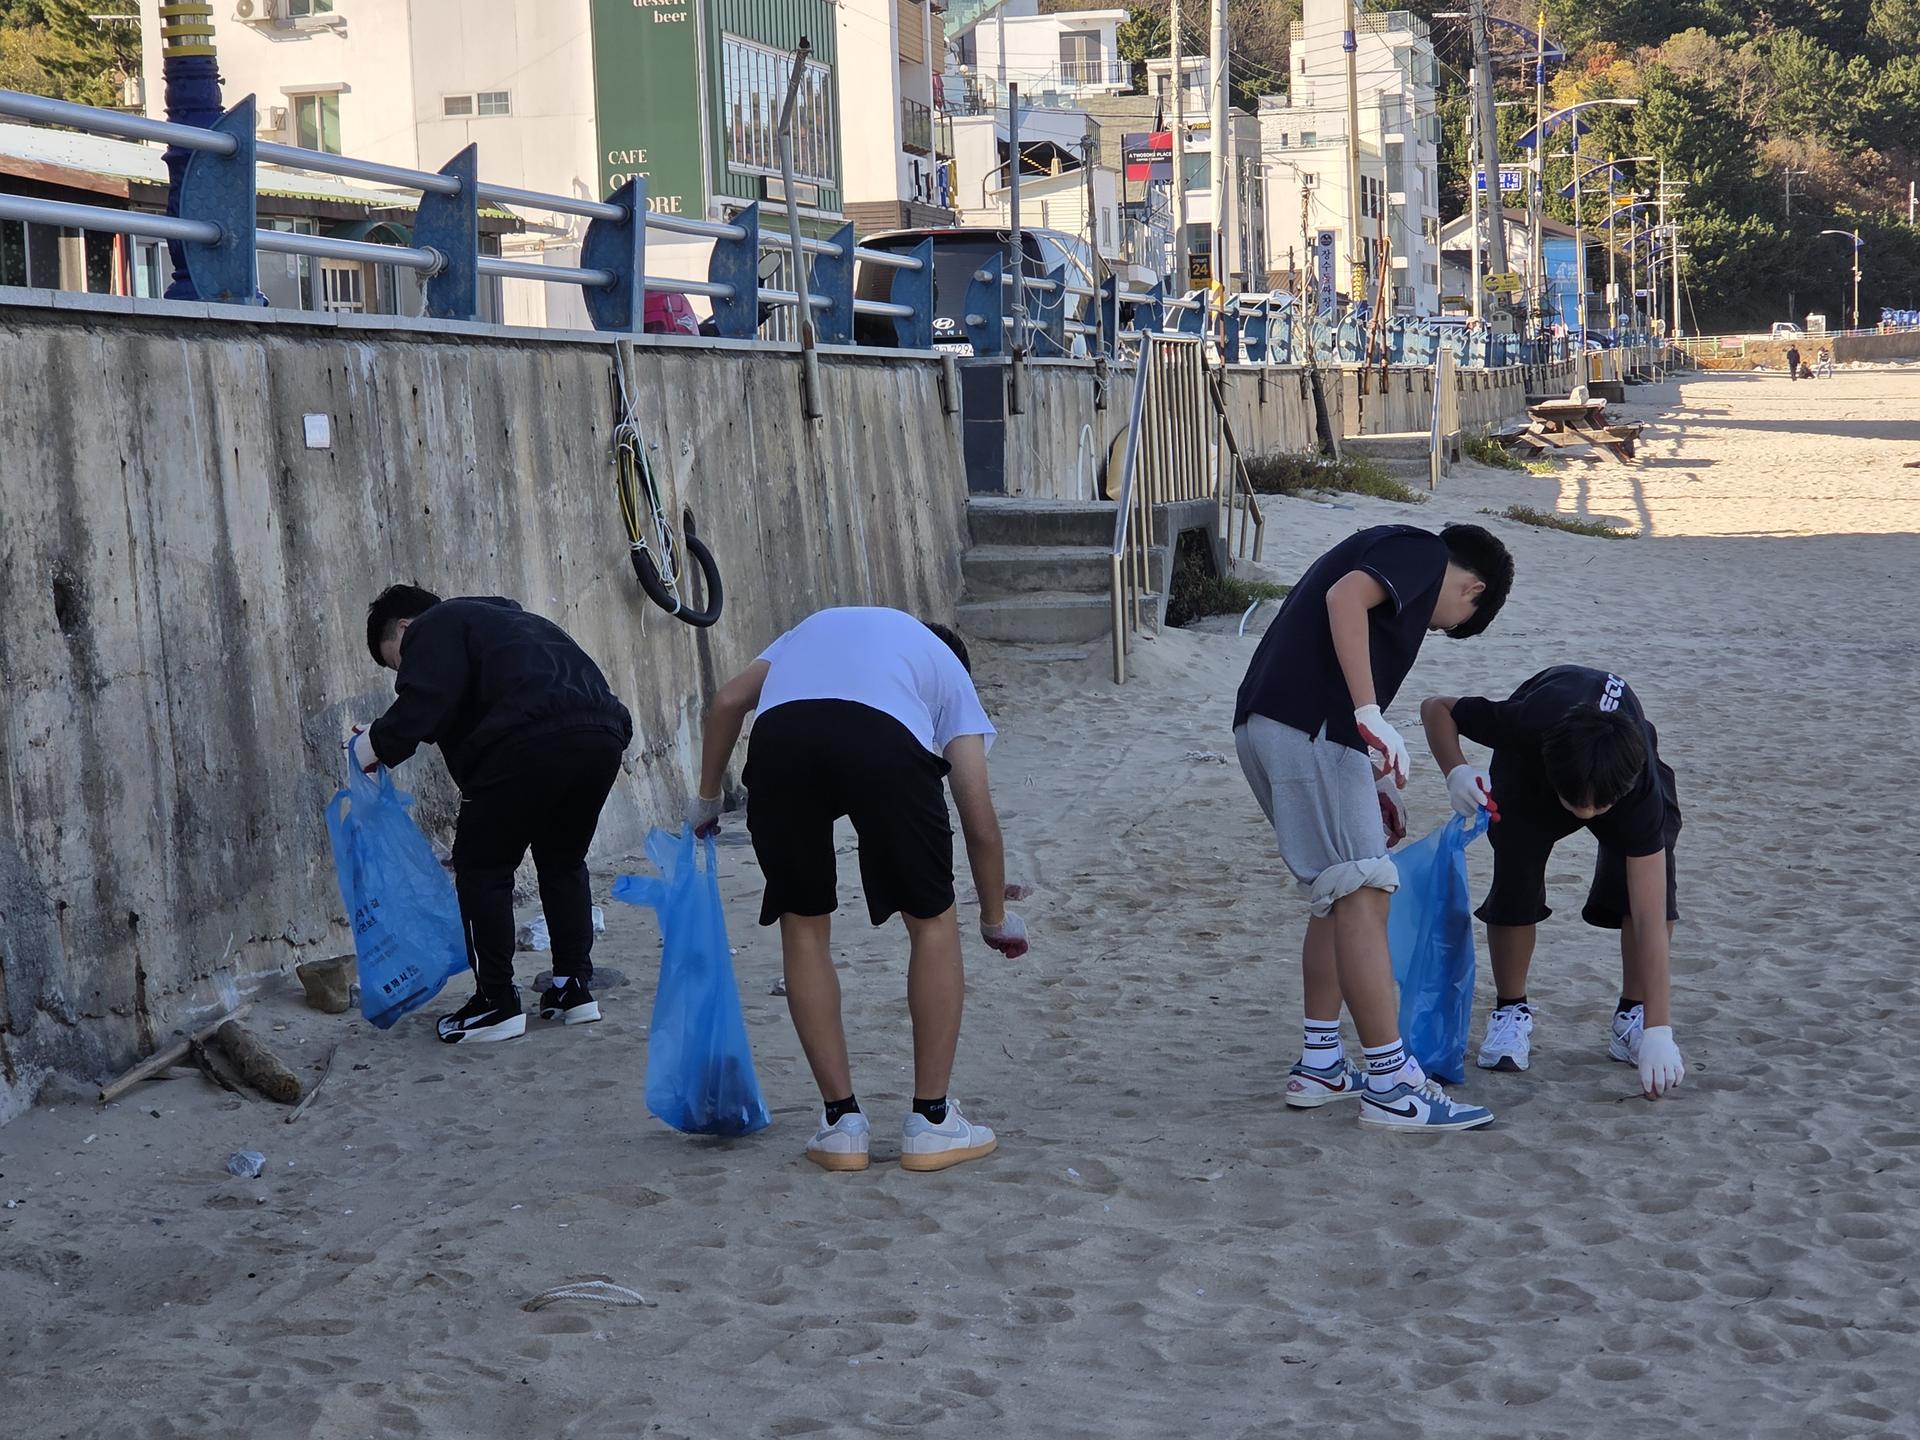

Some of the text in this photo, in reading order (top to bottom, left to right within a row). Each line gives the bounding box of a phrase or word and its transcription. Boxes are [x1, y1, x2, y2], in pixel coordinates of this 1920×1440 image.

[654, 10, 687, 23] beer
[608, 149, 647, 164] CAFE
[609, 172, 650, 191] OF
[645, 196, 682, 213] ORE
[1192, 264, 1208, 276] 24
[1369, 1055, 1403, 1069] Kodak
